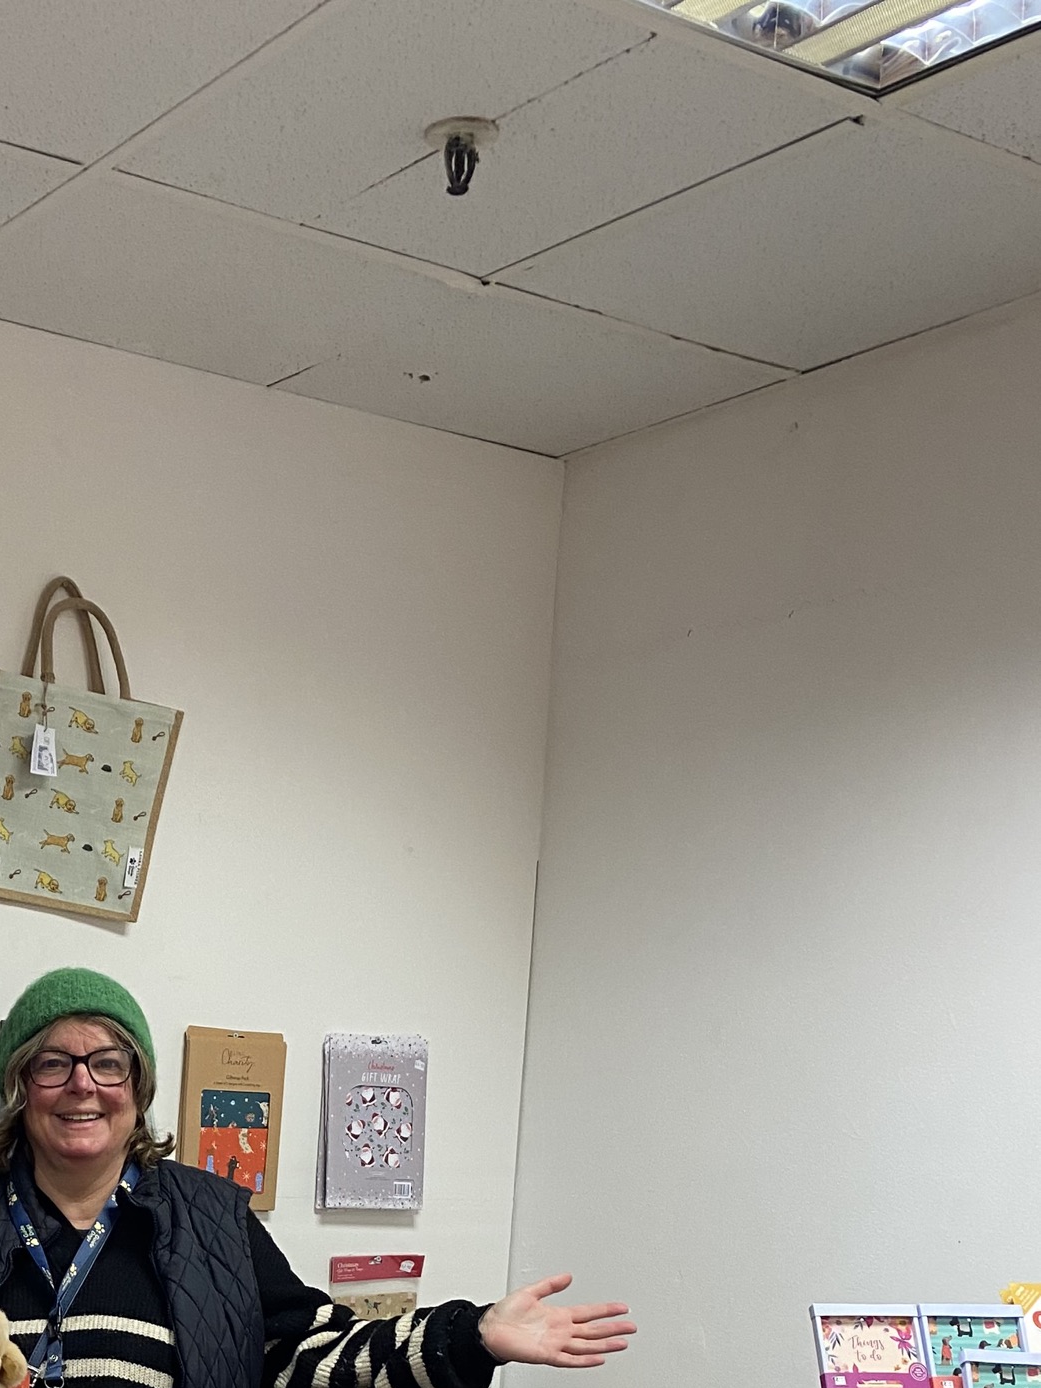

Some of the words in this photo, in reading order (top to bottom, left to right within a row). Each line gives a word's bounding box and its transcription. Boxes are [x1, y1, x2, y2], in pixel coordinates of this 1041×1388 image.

[361, 1072, 378, 1083] GIFT
[380, 1073, 401, 1084] WRAP
[848, 1335, 885, 1350] Things
[855, 1351, 868, 1361] to
[870, 1350, 882, 1361] do
